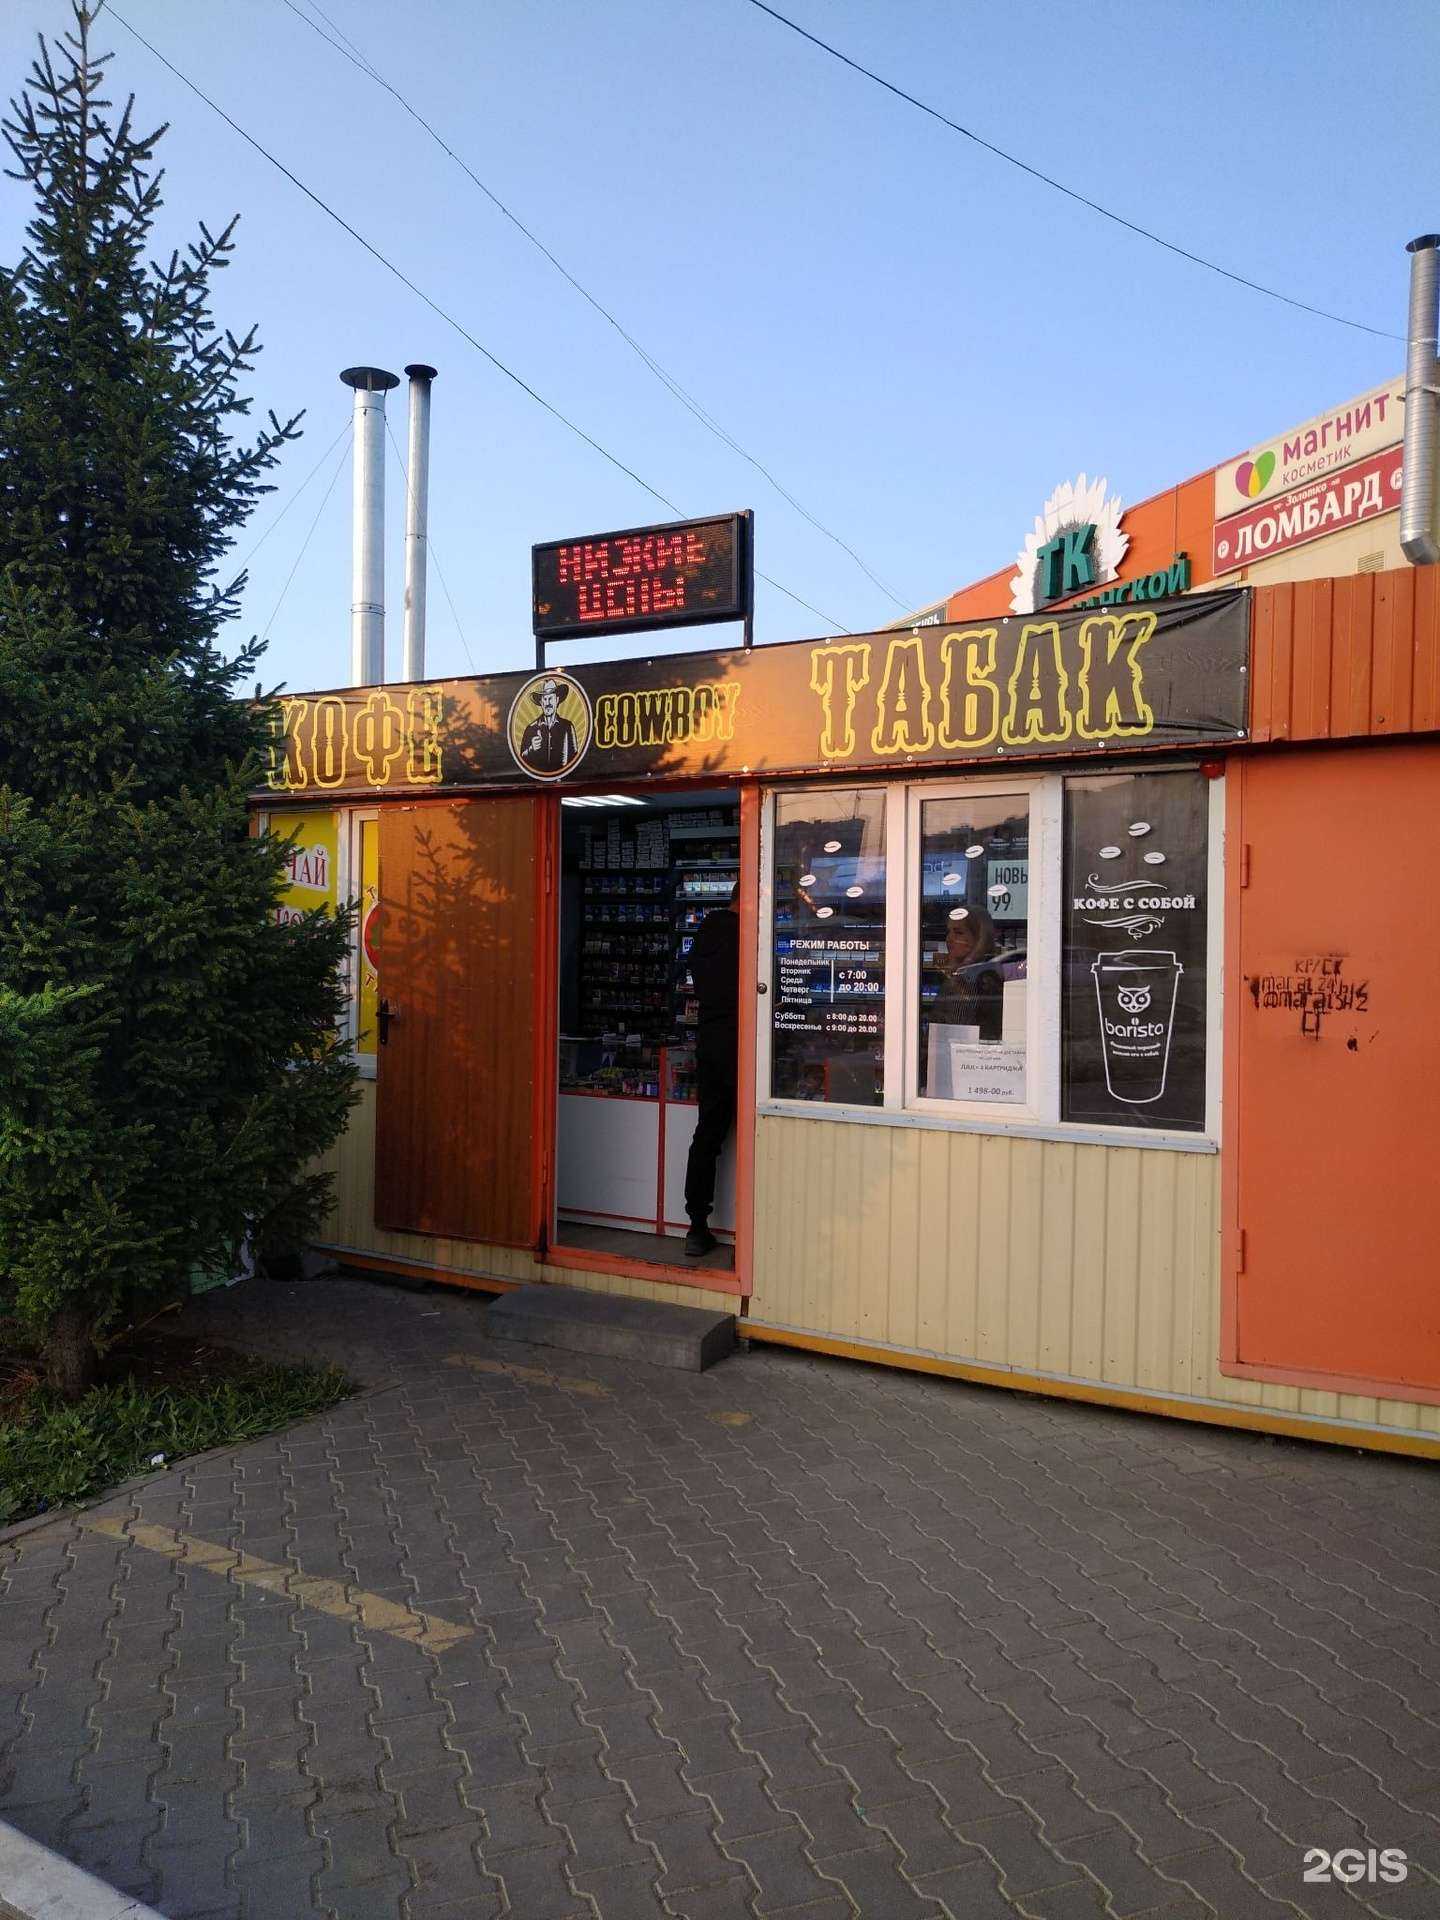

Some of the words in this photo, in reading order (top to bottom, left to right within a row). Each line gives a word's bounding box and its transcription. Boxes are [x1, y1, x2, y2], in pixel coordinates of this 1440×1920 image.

[1234, 470, 1383, 560] ЛОМБАРД
[1037, 523, 1098, 601] ТК
[810, 611, 1158, 758] ТАБАК
[595, 683, 741, 749] COWBOY
[268, 686, 444, 790] КОФЕ
[1073, 898, 1120, 910] КОФЕ
[1123, 897, 1134, 909] С
[1138, 894, 1196, 909] СОБОЙ
[789, 940, 825, 949] РЕЖИМ
[827, 940, 870, 950] РАБОТЫ
[780, 958, 830, 966] Понедельник
[780, 967, 811, 975] Вторник
[847, 970, 867, 979] 7:00
[780, 976, 803, 984] Среда
[780, 985, 810, 994] Четверг
[839, 984, 851, 992] до
[854, 982, 879, 992] 20:00
[781, 996, 812, 1004] Пятница
[774, 1011, 806, 1021] Суббота
[774, 1021, 822, 1031] Воскресенье
[1104, 1017, 1164, 1037] barista
